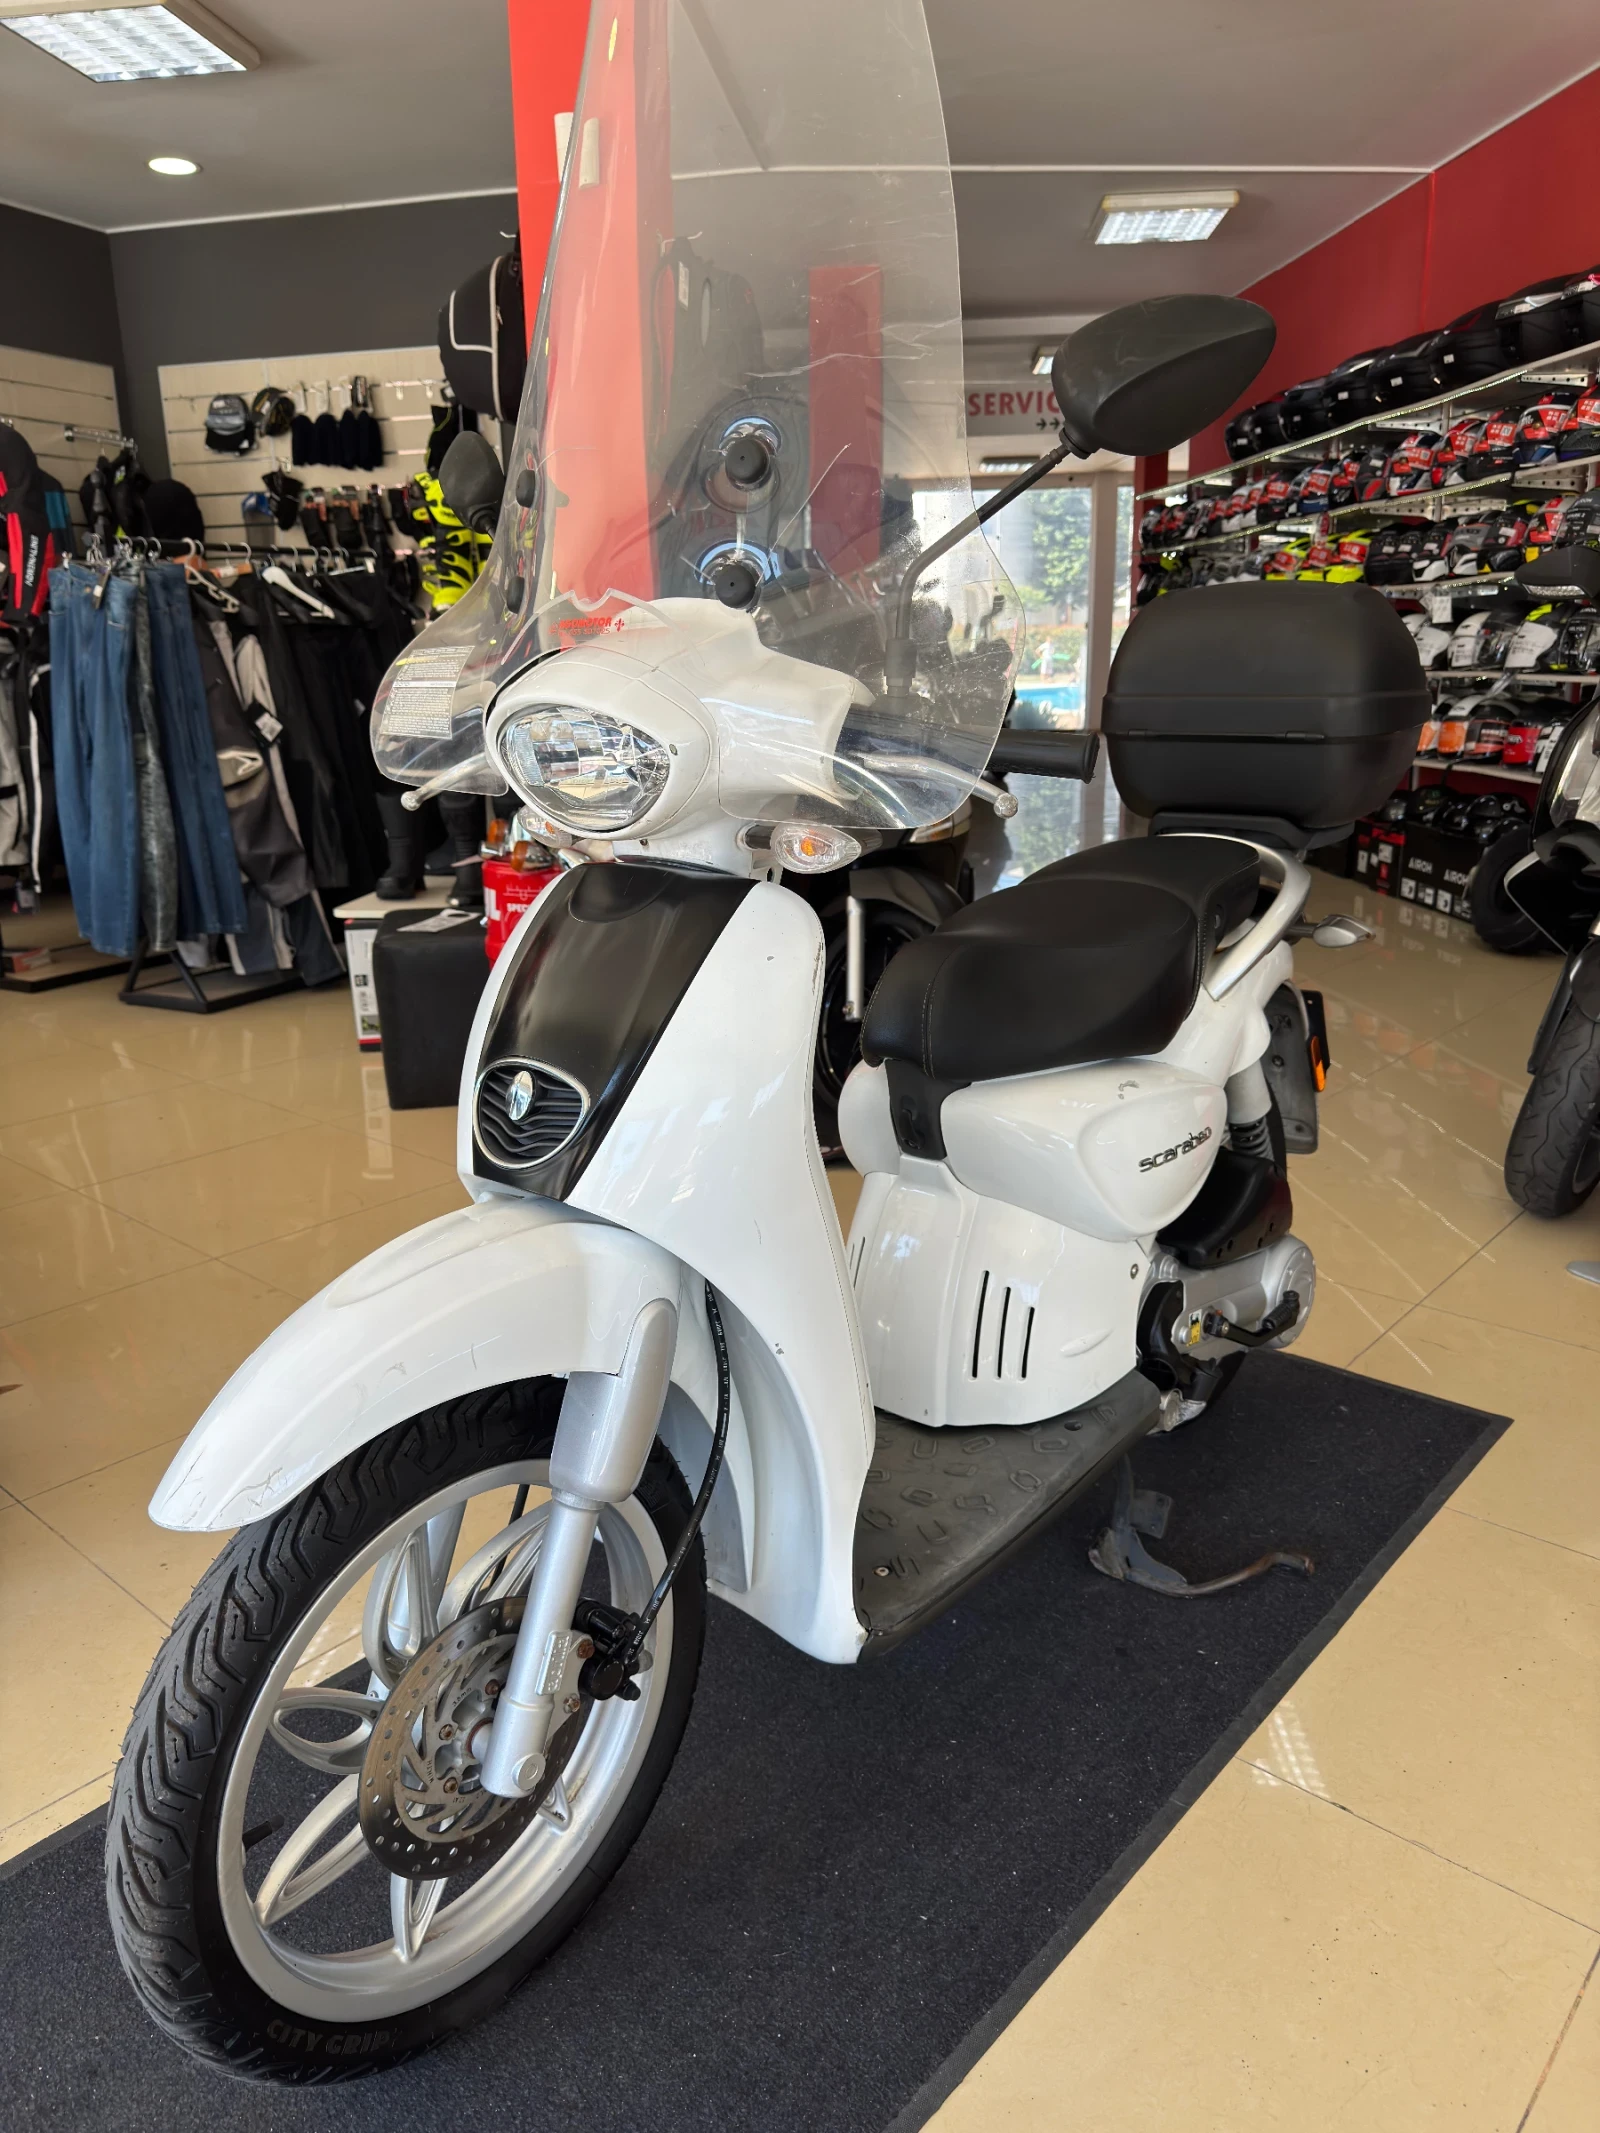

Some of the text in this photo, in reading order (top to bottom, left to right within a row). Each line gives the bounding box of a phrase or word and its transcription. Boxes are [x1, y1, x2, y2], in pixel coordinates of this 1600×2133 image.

[1408, 857, 1433, 874] AIROH
[1138, 1126, 1212, 1173] scarabeo
[267, 2019, 391, 2055] CITY GRIP
